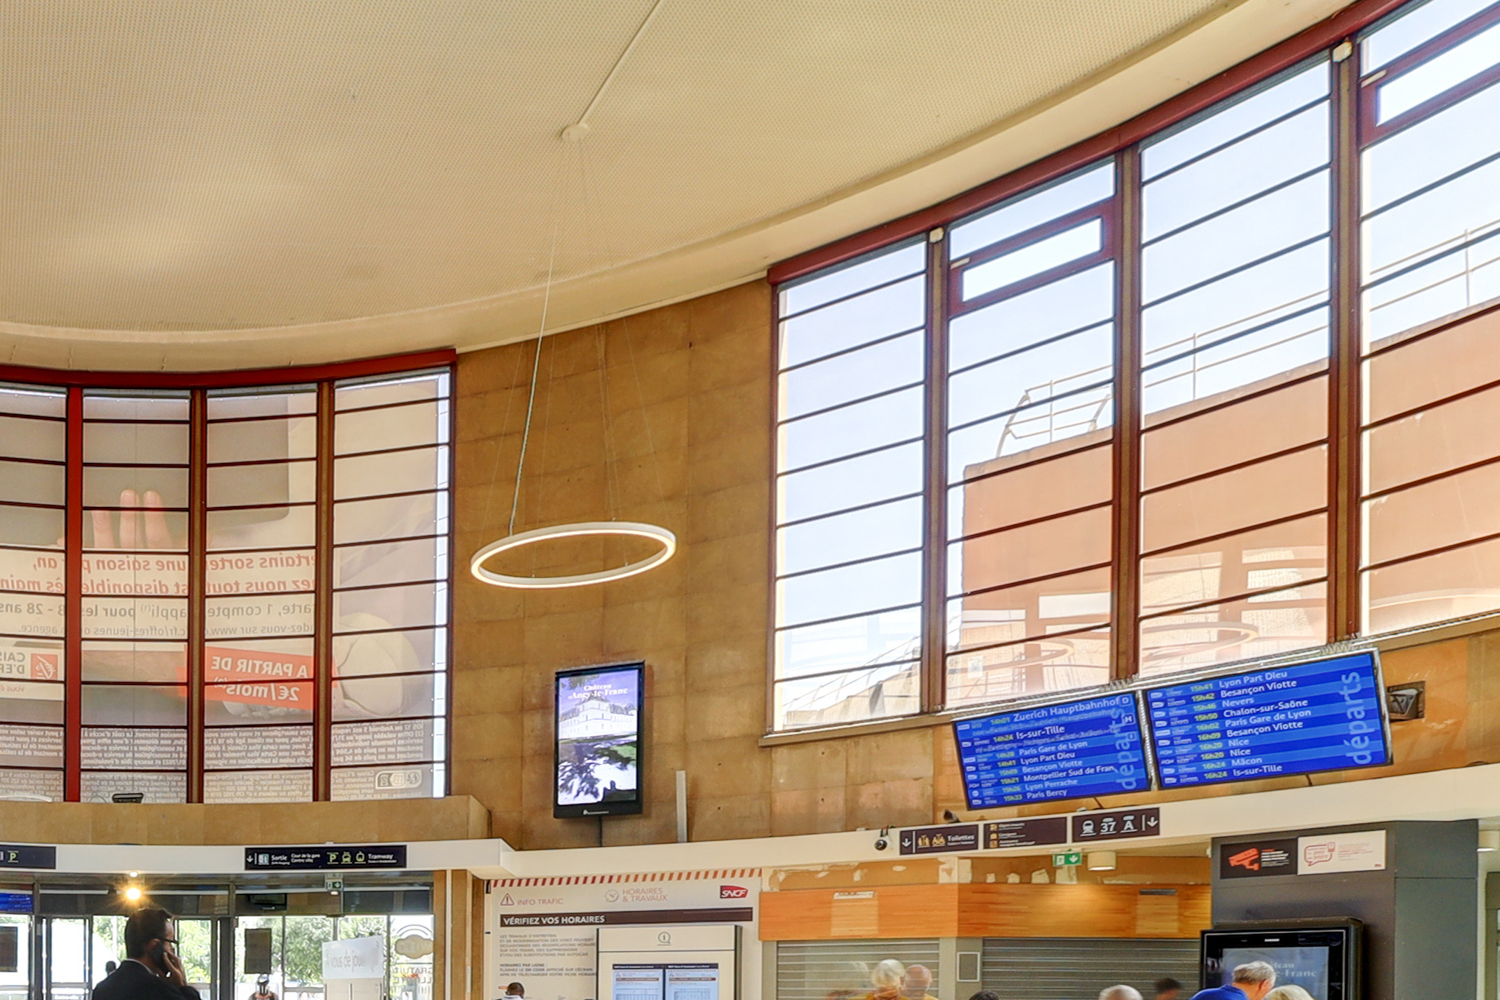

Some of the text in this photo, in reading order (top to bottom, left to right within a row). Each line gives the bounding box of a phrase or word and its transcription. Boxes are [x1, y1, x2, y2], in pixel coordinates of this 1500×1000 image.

[1219, 671, 1288, 689] Lyon Part Dieu
[584, 683, 612, 691] Château
[1220, 680, 1298, 698] Besançon Viotte
[1222, 697, 1255, 708] Nevers
[1013, 710, 1048, 722] Zuerich
[1049, 697, 1120, 716] Hauptbahnhof
[1224, 700, 1309, 718] Chalon-sur-Saône
[1225, 710, 1312, 727] Paris Gare de Lyon
[1337, 670, 1375, 765] départs
[1016, 725, 1066, 740] Is-sur-Tille
[1227, 721, 1304, 738] Besançon Viotte
[1019, 741, 1088, 756] Paris Gare de Lyon
[1109, 707, 1139, 790] départs
[1228, 739, 1250, 747] Nice
[1020, 752, 1076, 765] Lyon Part Dieu
[1230, 748, 1252, 757] Nice
[1022, 760, 1083, 774] Besançon Viotte
[1231, 757, 1263, 767] Mâcon
[1023, 766, 1095, 782] Montpellier Sud de
[1233, 765, 1283, 776] Is-sur-Tille
[1025, 779, 1078, 792] Lyon Perrache
[1026, 789, 1068, 800] Paris Bercy
[1100, 820, 1134, 832] 37 A
[947, 833, 975, 842] Toilettes
[10, 852, 17, 861] P
[330, 853, 337, 862] P
[622, 888, 663, 896] HORAIRES
[630, 894, 668, 902] TRAVAUX
[721, 889, 748, 898] SNCF
[503, 915, 605, 925] VÉRIFIEZ VOS HORAIRES
